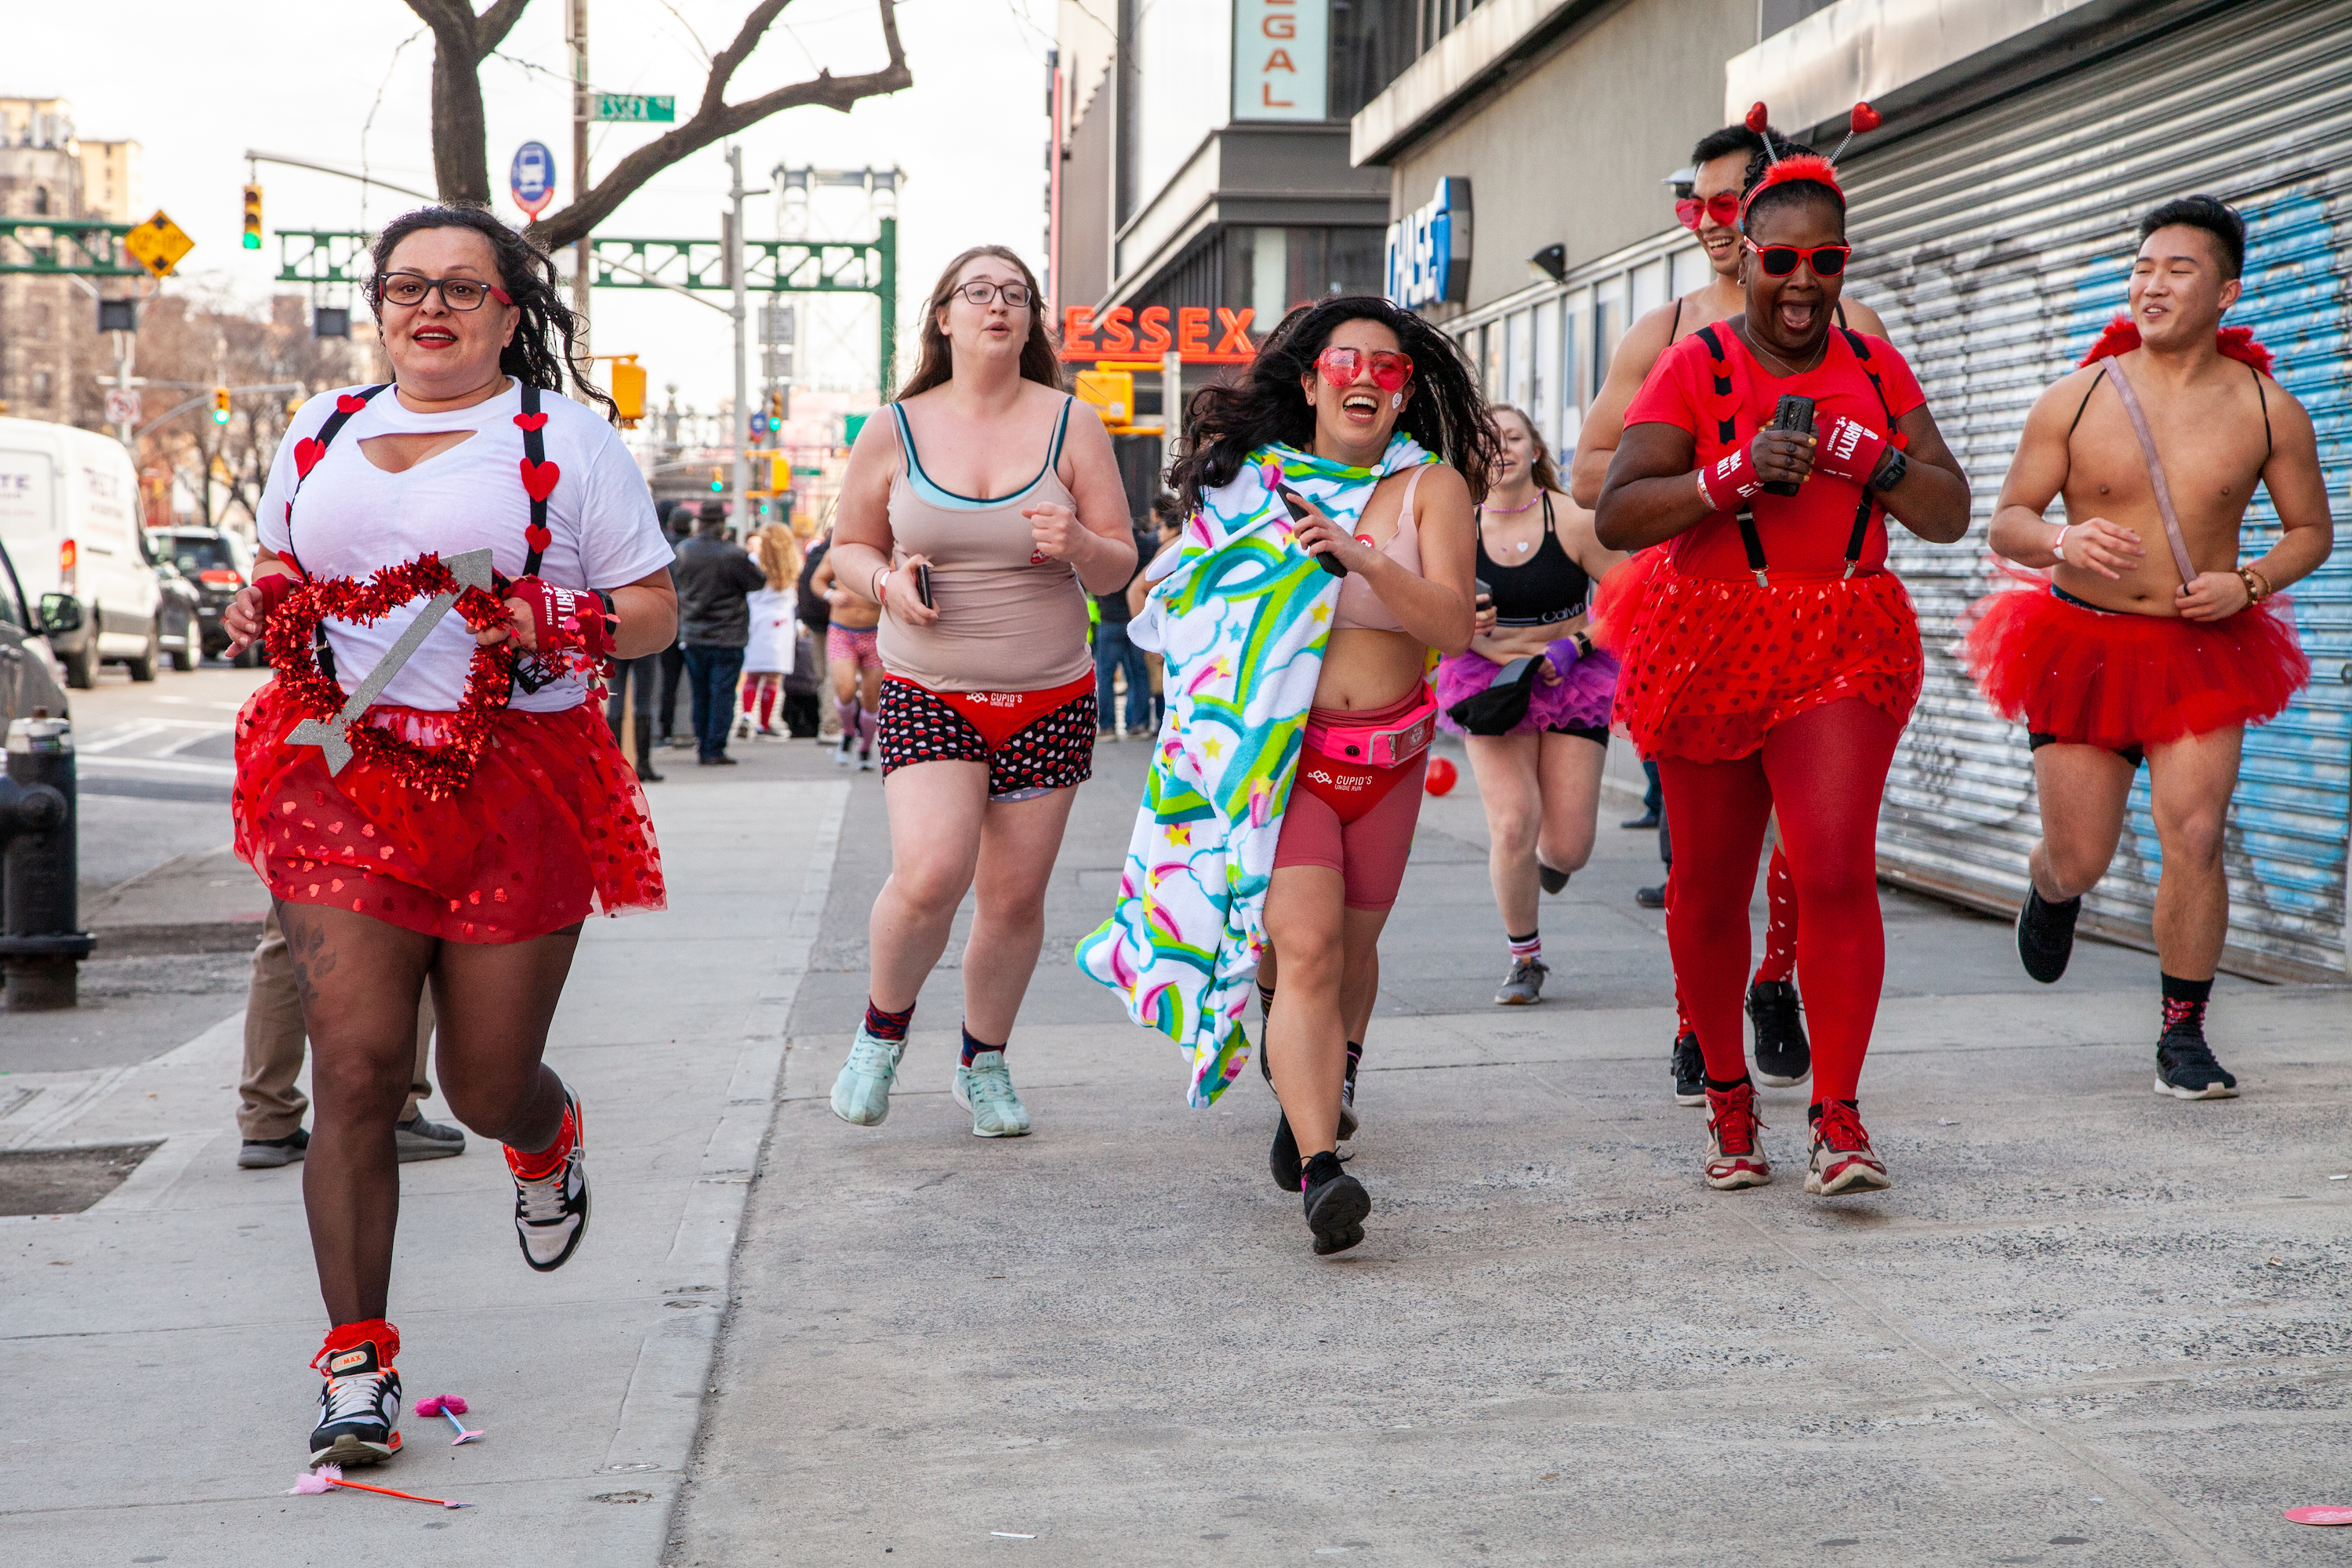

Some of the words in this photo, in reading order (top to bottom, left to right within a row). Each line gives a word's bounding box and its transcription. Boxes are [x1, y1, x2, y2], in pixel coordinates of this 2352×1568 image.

[1262, 0, 1296, 107] GAL
[1385, 201, 1436, 308] CHASE
[1065, 305, 1256, 354] ESSEX
[544, 596, 553, 626] CHARITIES
[1541, 601, 1584, 623] Calvin
[990, 692, 1022, 703] CUPID'S
[1336, 775, 1373, 786] CUPID'S
